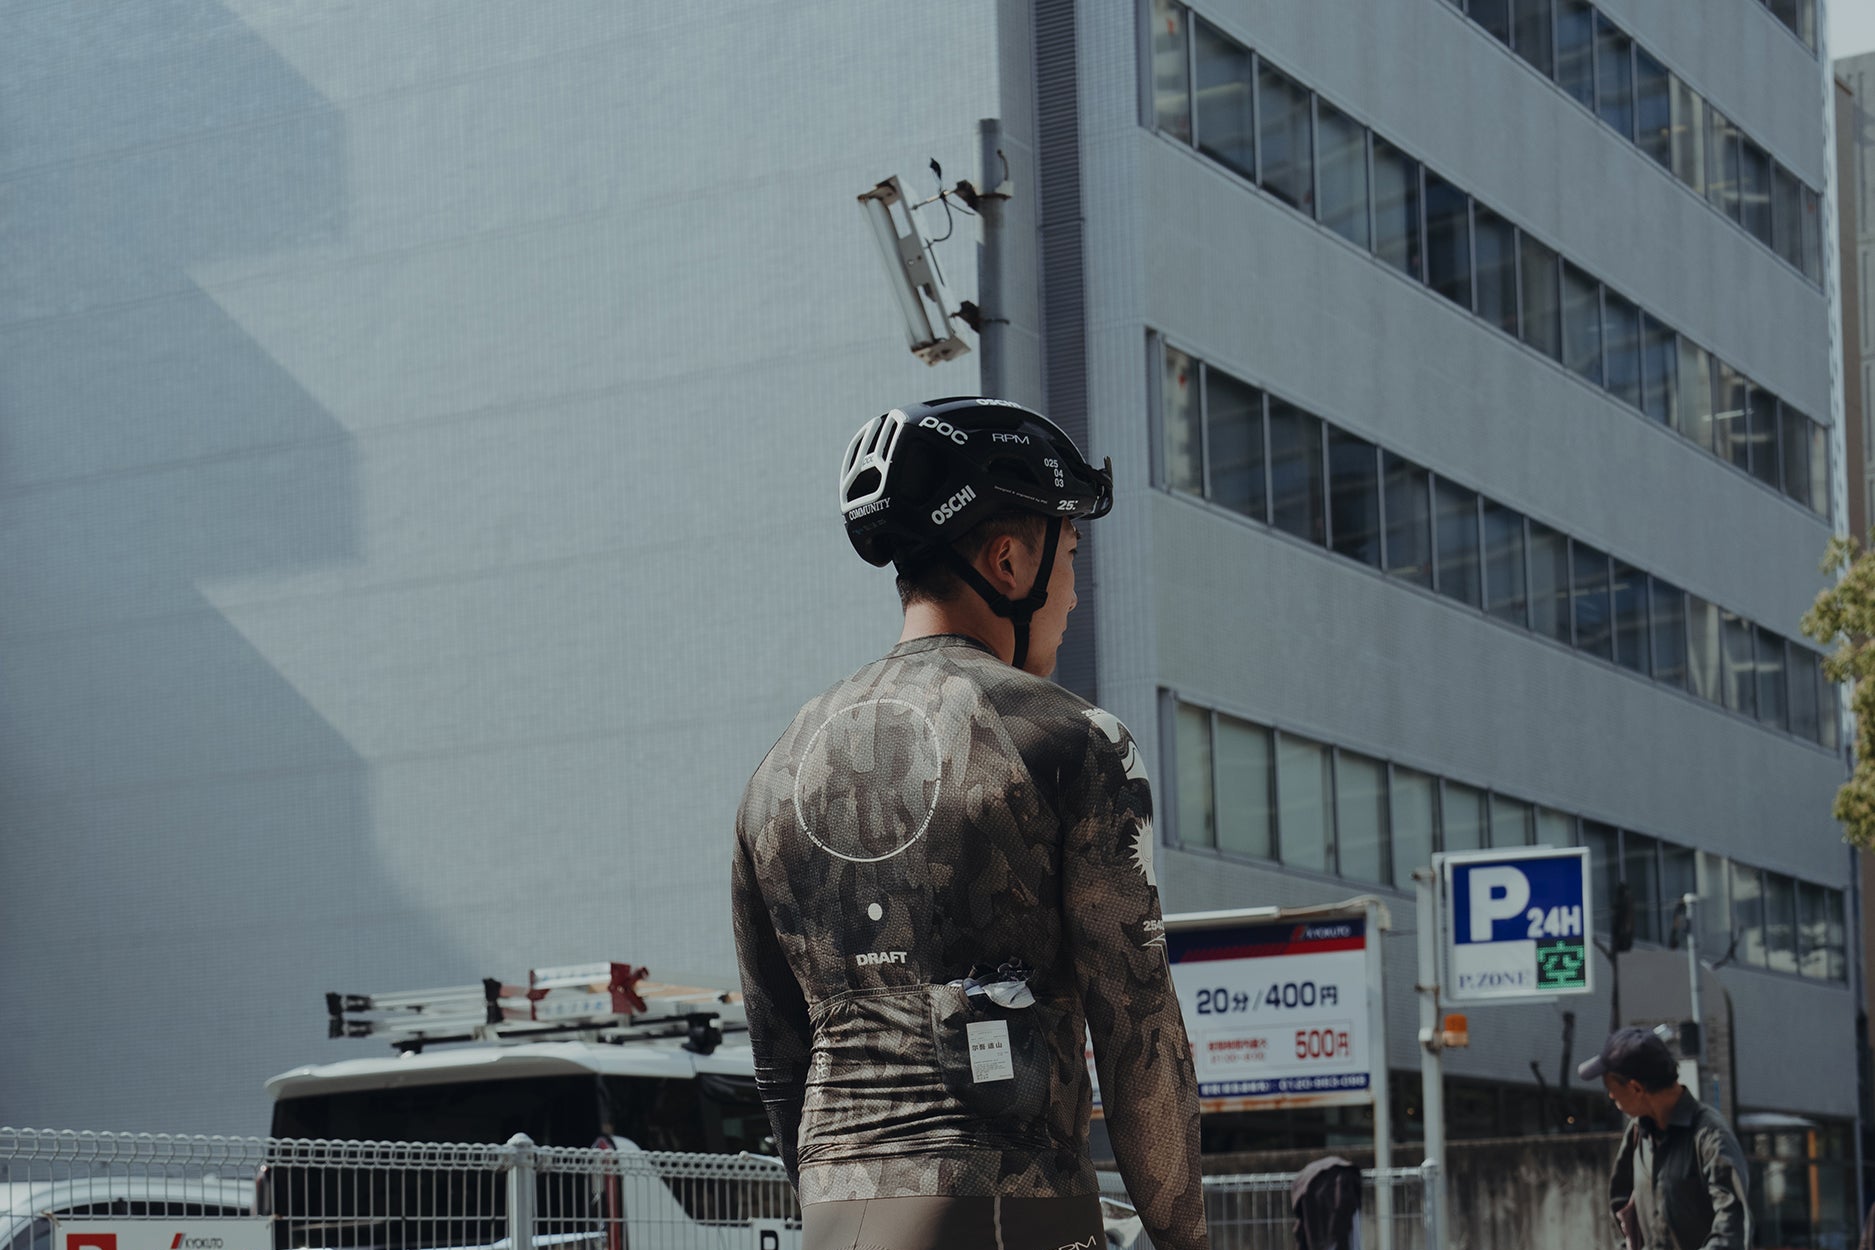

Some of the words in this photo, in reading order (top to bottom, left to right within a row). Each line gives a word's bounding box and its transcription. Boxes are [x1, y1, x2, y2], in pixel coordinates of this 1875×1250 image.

[918, 416, 969, 445] POC
[992, 433, 1030, 445] RPM
[848, 497, 891, 521] COMMUNITY
[931, 484, 977, 526] OSCHI
[1469, 866, 1531, 942] P
[1526, 905, 1582, 938] 24H
[855, 951, 908, 966] DRAFT
[1536, 940, 1586, 990] 空
[1296, 1029, 1350, 1060] 500円
[185, 1238, 224, 1250] KYOKUTO
